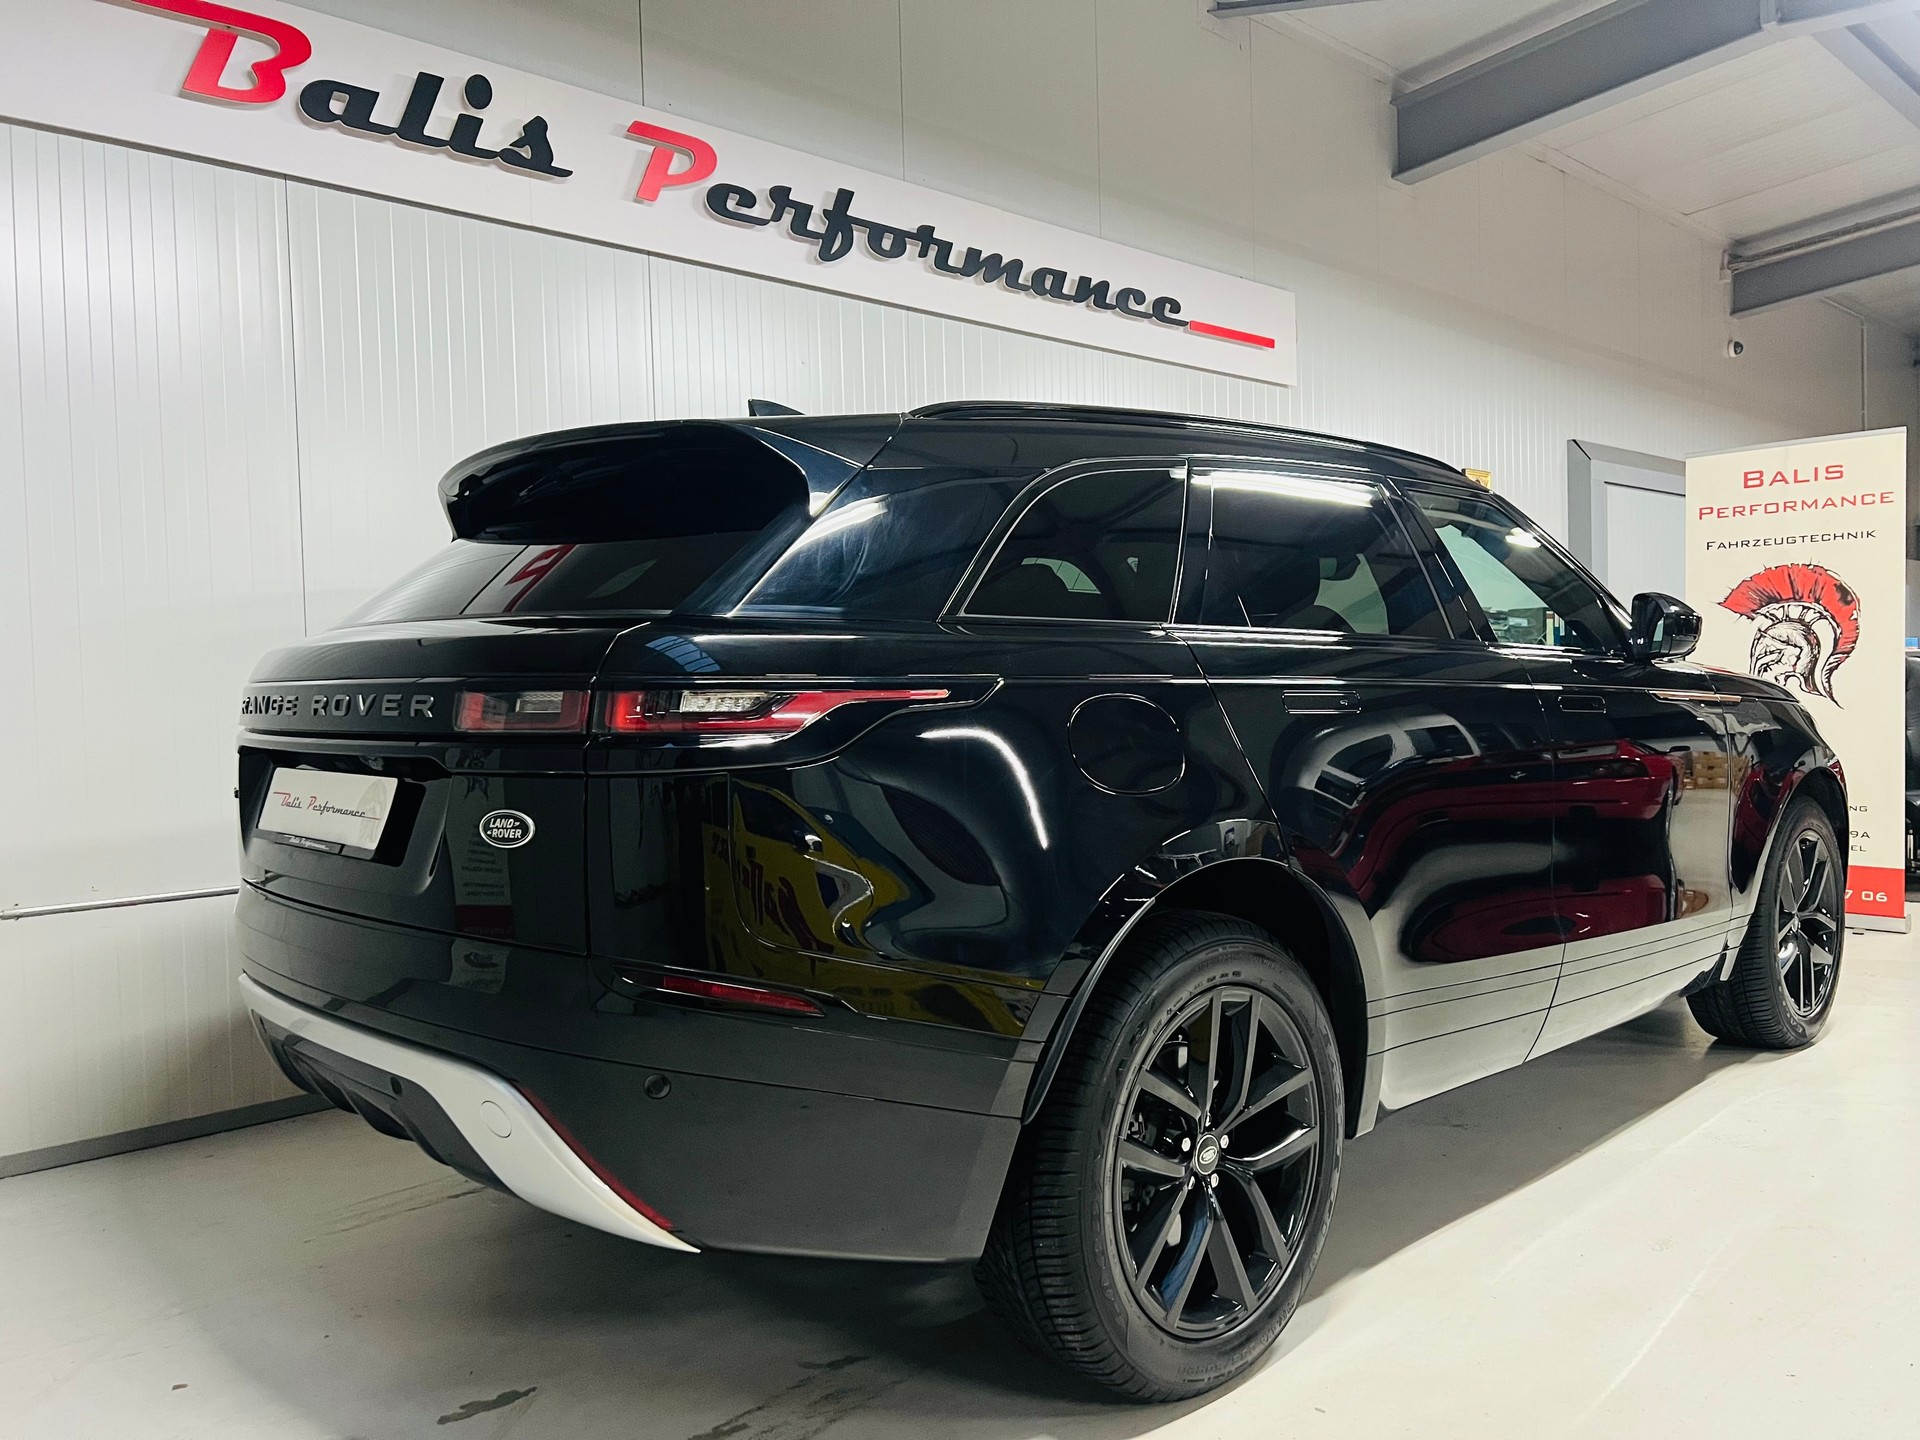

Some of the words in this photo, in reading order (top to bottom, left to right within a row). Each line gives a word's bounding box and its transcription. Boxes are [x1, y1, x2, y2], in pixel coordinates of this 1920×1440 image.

[100, 0, 573, 177] Balis
[626, 119, 1190, 328] Performance
[1743, 464, 1844, 489] BALIS
[1698, 491, 1895, 520] PERFORMANCE
[1706, 529, 1876, 551] FAHRZEUGTECHNIK
[241, 695, 298, 715] RANGE
[311, 694, 434, 718] ROVER
[489, 818, 515, 828] LAND
[491, 828, 522, 839] ROVER
